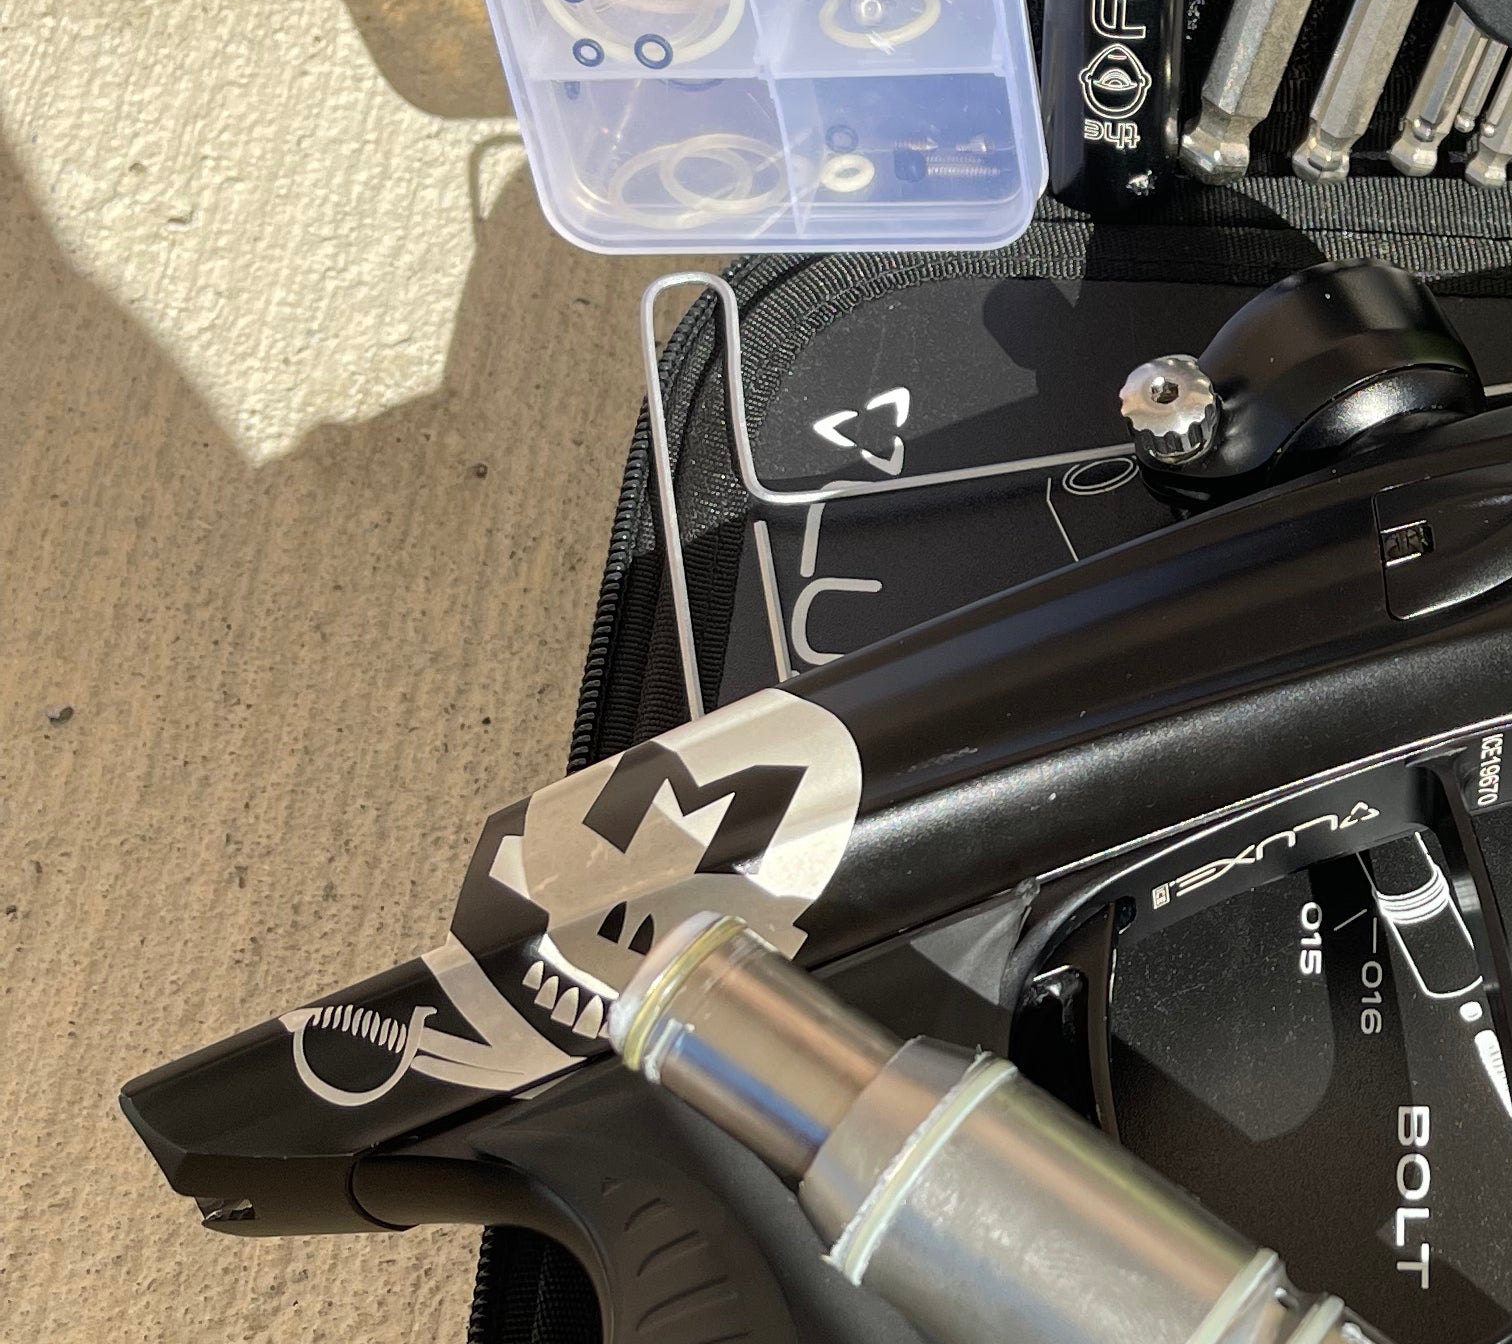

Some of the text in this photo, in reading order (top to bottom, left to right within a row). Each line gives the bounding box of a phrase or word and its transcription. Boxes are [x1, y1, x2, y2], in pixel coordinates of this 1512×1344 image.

[1477, 733, 1505, 807] ICE19670
[1299, 901, 1323, 976] 015
[1359, 960, 1383, 1035] 016
[1395, 1105, 1431, 1289] BOLT
